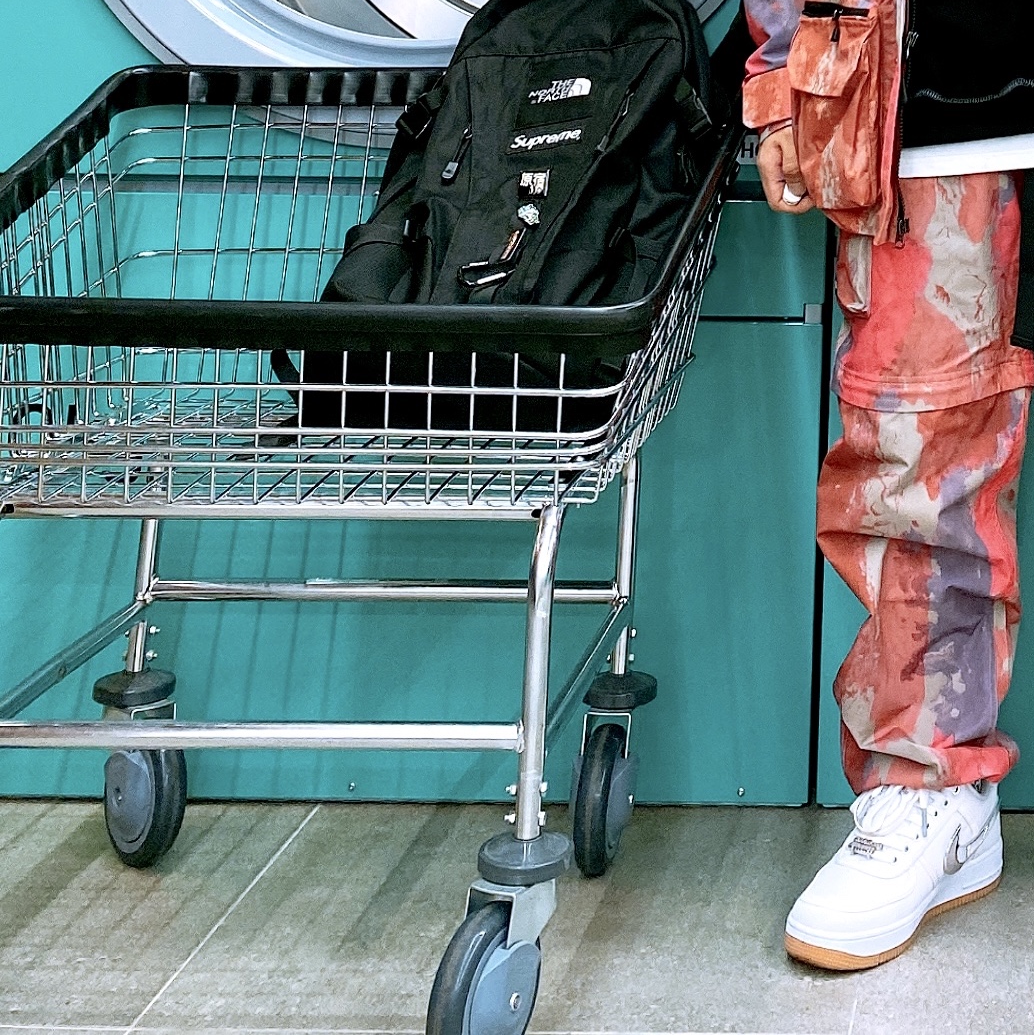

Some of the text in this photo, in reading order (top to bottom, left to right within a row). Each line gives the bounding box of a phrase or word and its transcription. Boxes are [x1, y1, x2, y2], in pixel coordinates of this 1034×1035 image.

[552, 79, 575, 88] THE
[538, 93, 568, 103] FACE
[510, 130, 581, 150] Supreme
